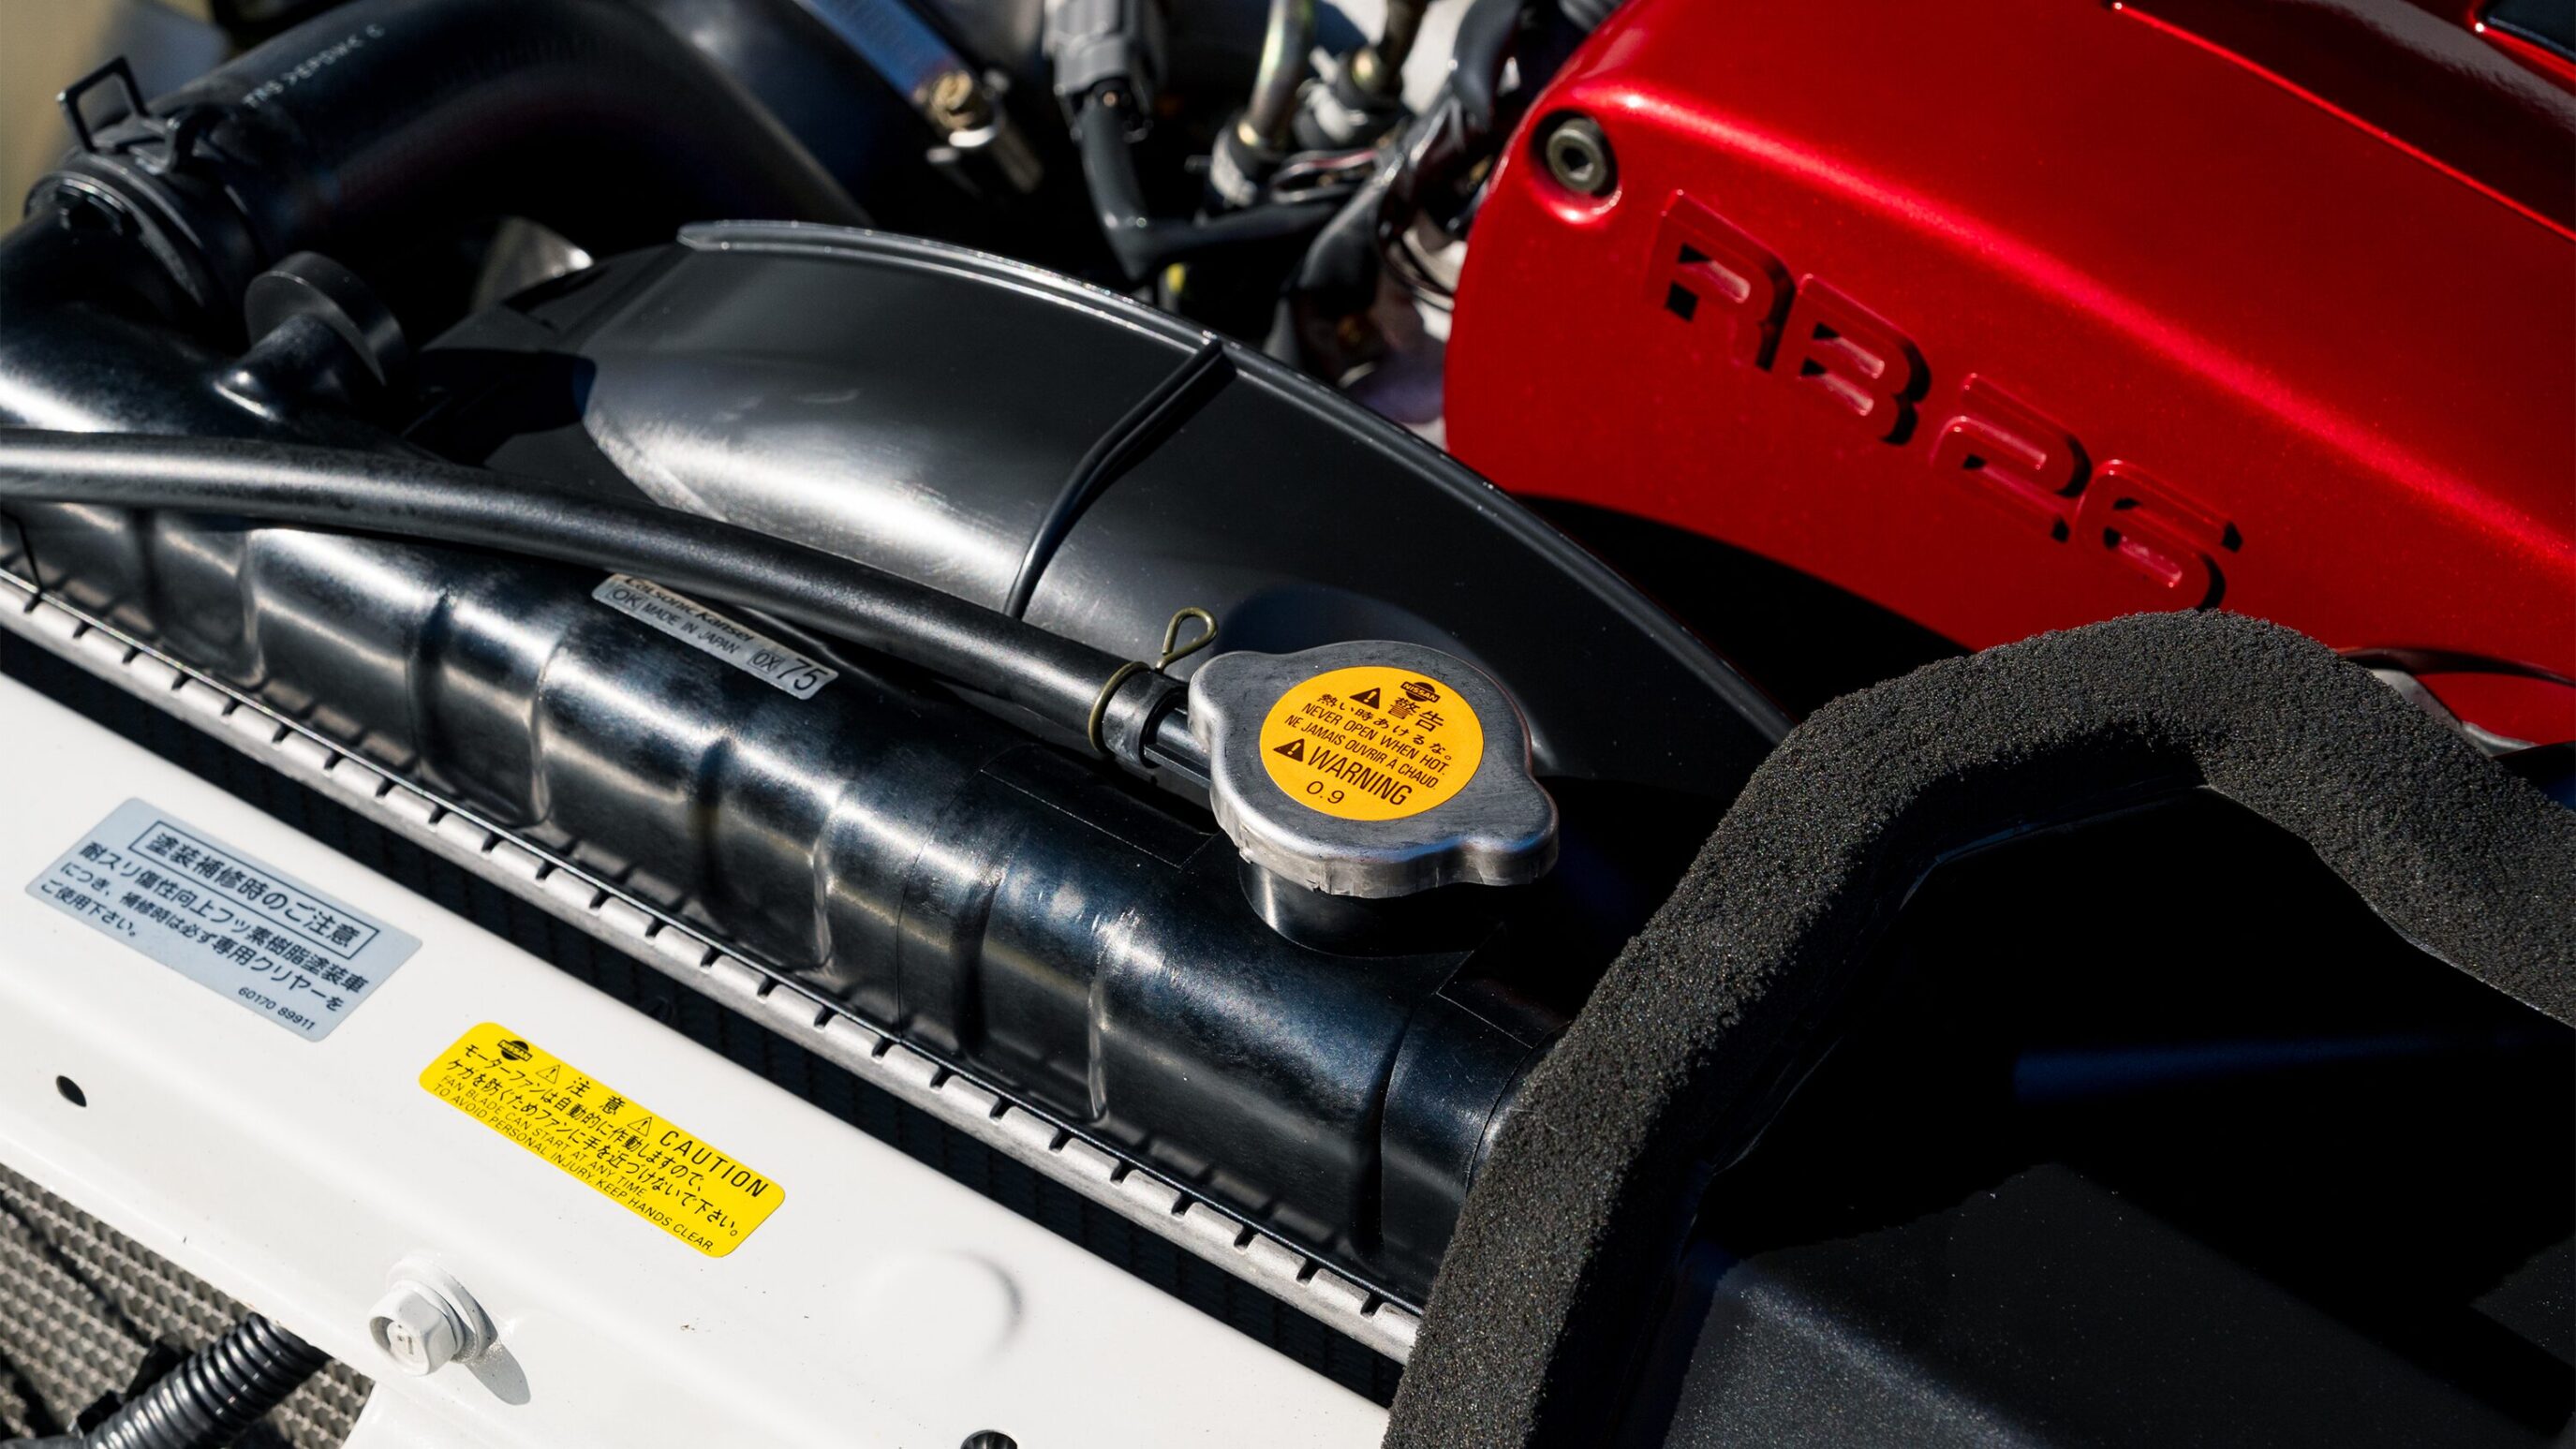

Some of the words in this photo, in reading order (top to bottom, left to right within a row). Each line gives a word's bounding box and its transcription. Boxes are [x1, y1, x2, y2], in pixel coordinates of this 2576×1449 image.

[612, 588, 644, 608] OK
[642, 602, 680, 626] MADE
[680, 621, 699, 634] IN
[697, 631, 743, 655] JAPAN
[777, 658, 829, 690] 75
[1402, 682, 1440, 702] NISSAN
[1302, 702, 1344, 726] NEVER
[1344, 720, 1380, 741] OPEN
[1380, 735, 1422, 760] WHEN
[1421, 755, 1450, 776] HOT.
[1387, 696, 1445, 732] 警告
[1285, 715, 1302, 728] NE
[1301, 722, 1345, 746] JAMAIS
[1345, 740, 1388, 763] OUVRIR
[1398, 763, 1438, 791] CHAUD.
[1308, 747, 1413, 806] WARNING
[1306, 781, 1345, 805] 0.9
[146, 833, 361, 948] 塗装補修時のご注意
[238, 987, 276, 1010] 60170
[277, 1007, 316, 1030] 89911
[441, 1075, 466, 1092] FAN
[467, 1088, 506, 1116] BLADE
[505, 1111, 533, 1130] CAN
[532, 1128, 571, 1152] START
[570, 1151, 588, 1162] AT
[589, 1161, 616, 1177] ANY
[434, 1084, 451, 1097] TO
[452, 1092, 488, 1118] AVOID
[488, 1116, 548, 1155] PERSONAL
[596, 1179, 628, 1198] KEEP
[628, 1198, 673, 1227] HANDS
[673, 1223, 714, 1252] CLEAR.
[659, 1131, 769, 1197] CAUTION
